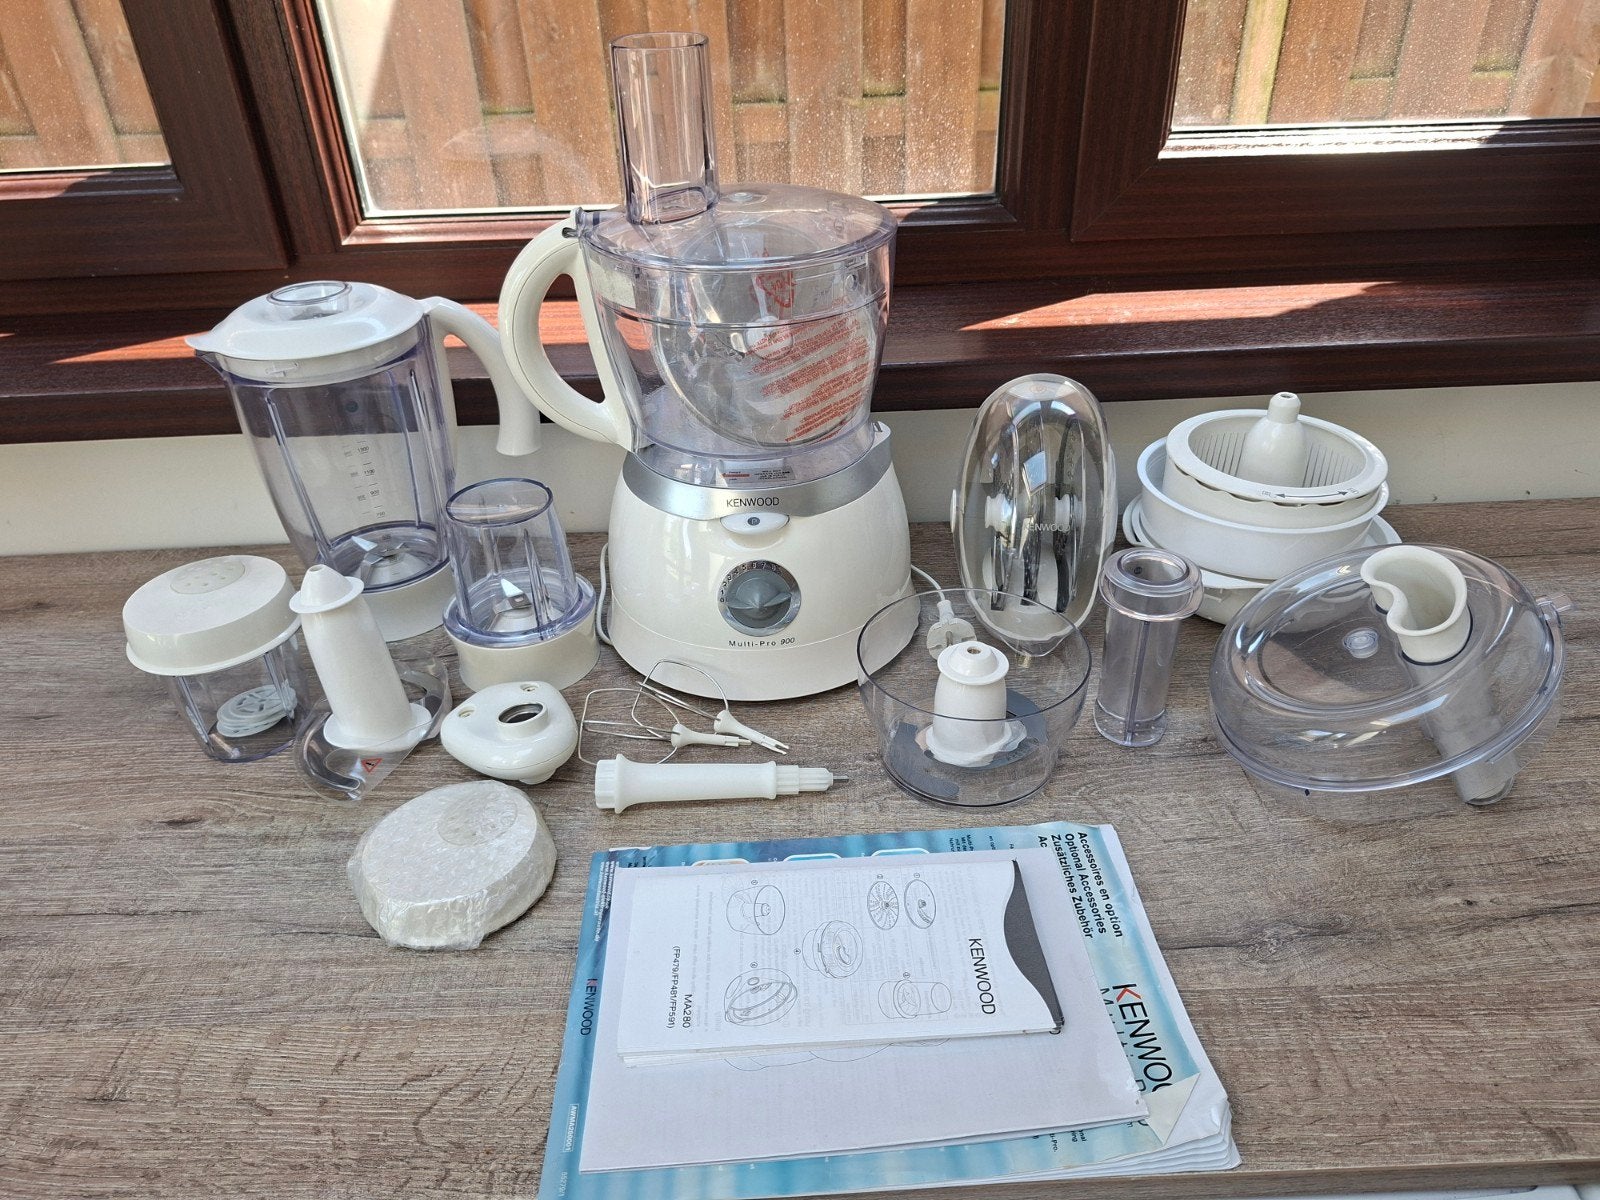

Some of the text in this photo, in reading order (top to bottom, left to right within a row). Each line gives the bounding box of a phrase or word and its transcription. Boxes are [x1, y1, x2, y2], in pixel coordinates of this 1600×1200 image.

[726, 497, 780, 507] KENWOOD
[1027, 523, 1070, 531] ENWOOD
[780, 637, 795, 645] 900
[1051, 834, 1094, 938] Zusätzliches Zubehör
[1065, 833, 1107, 934] Optional Accessories
[1077, 832, 1123, 937] Accessoires en option
[580, 978, 598, 1035] KENWOOD
[666, 946, 681, 1028] (FP479/FP481/FP591)
[968, 938, 996, 1014] KENWOOD
[682, 994, 693, 1028] MA280
